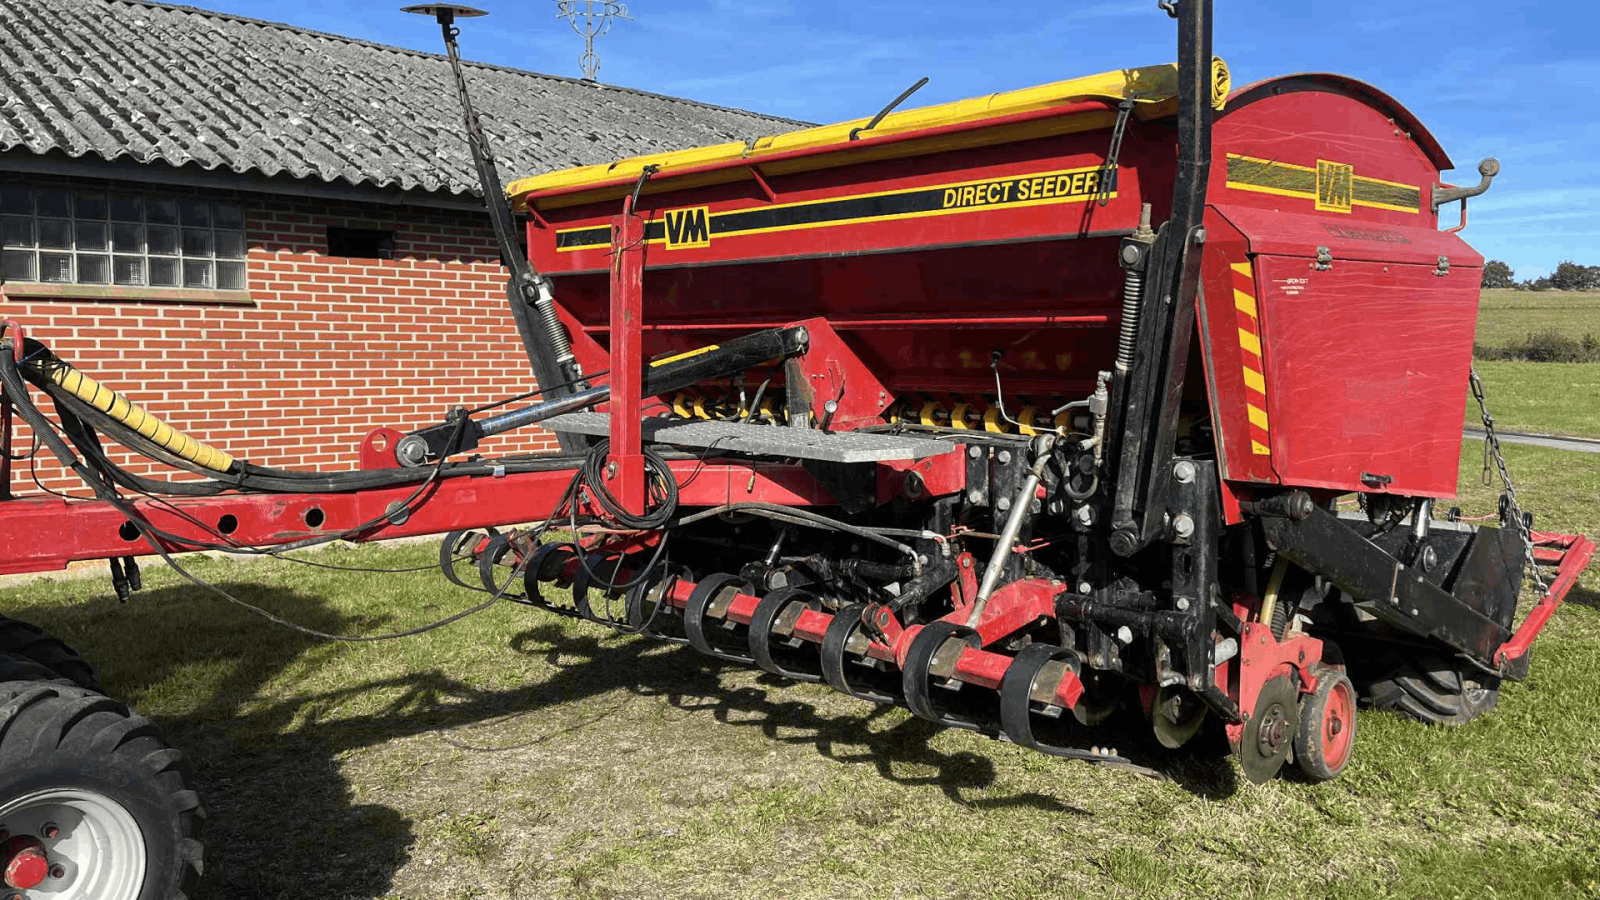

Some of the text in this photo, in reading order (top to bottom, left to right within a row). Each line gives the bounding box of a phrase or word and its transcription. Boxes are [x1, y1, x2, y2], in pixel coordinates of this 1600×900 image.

[943, 172, 1099, 208] DIRECT SEEDER
[665, 208, 709, 244] VM
